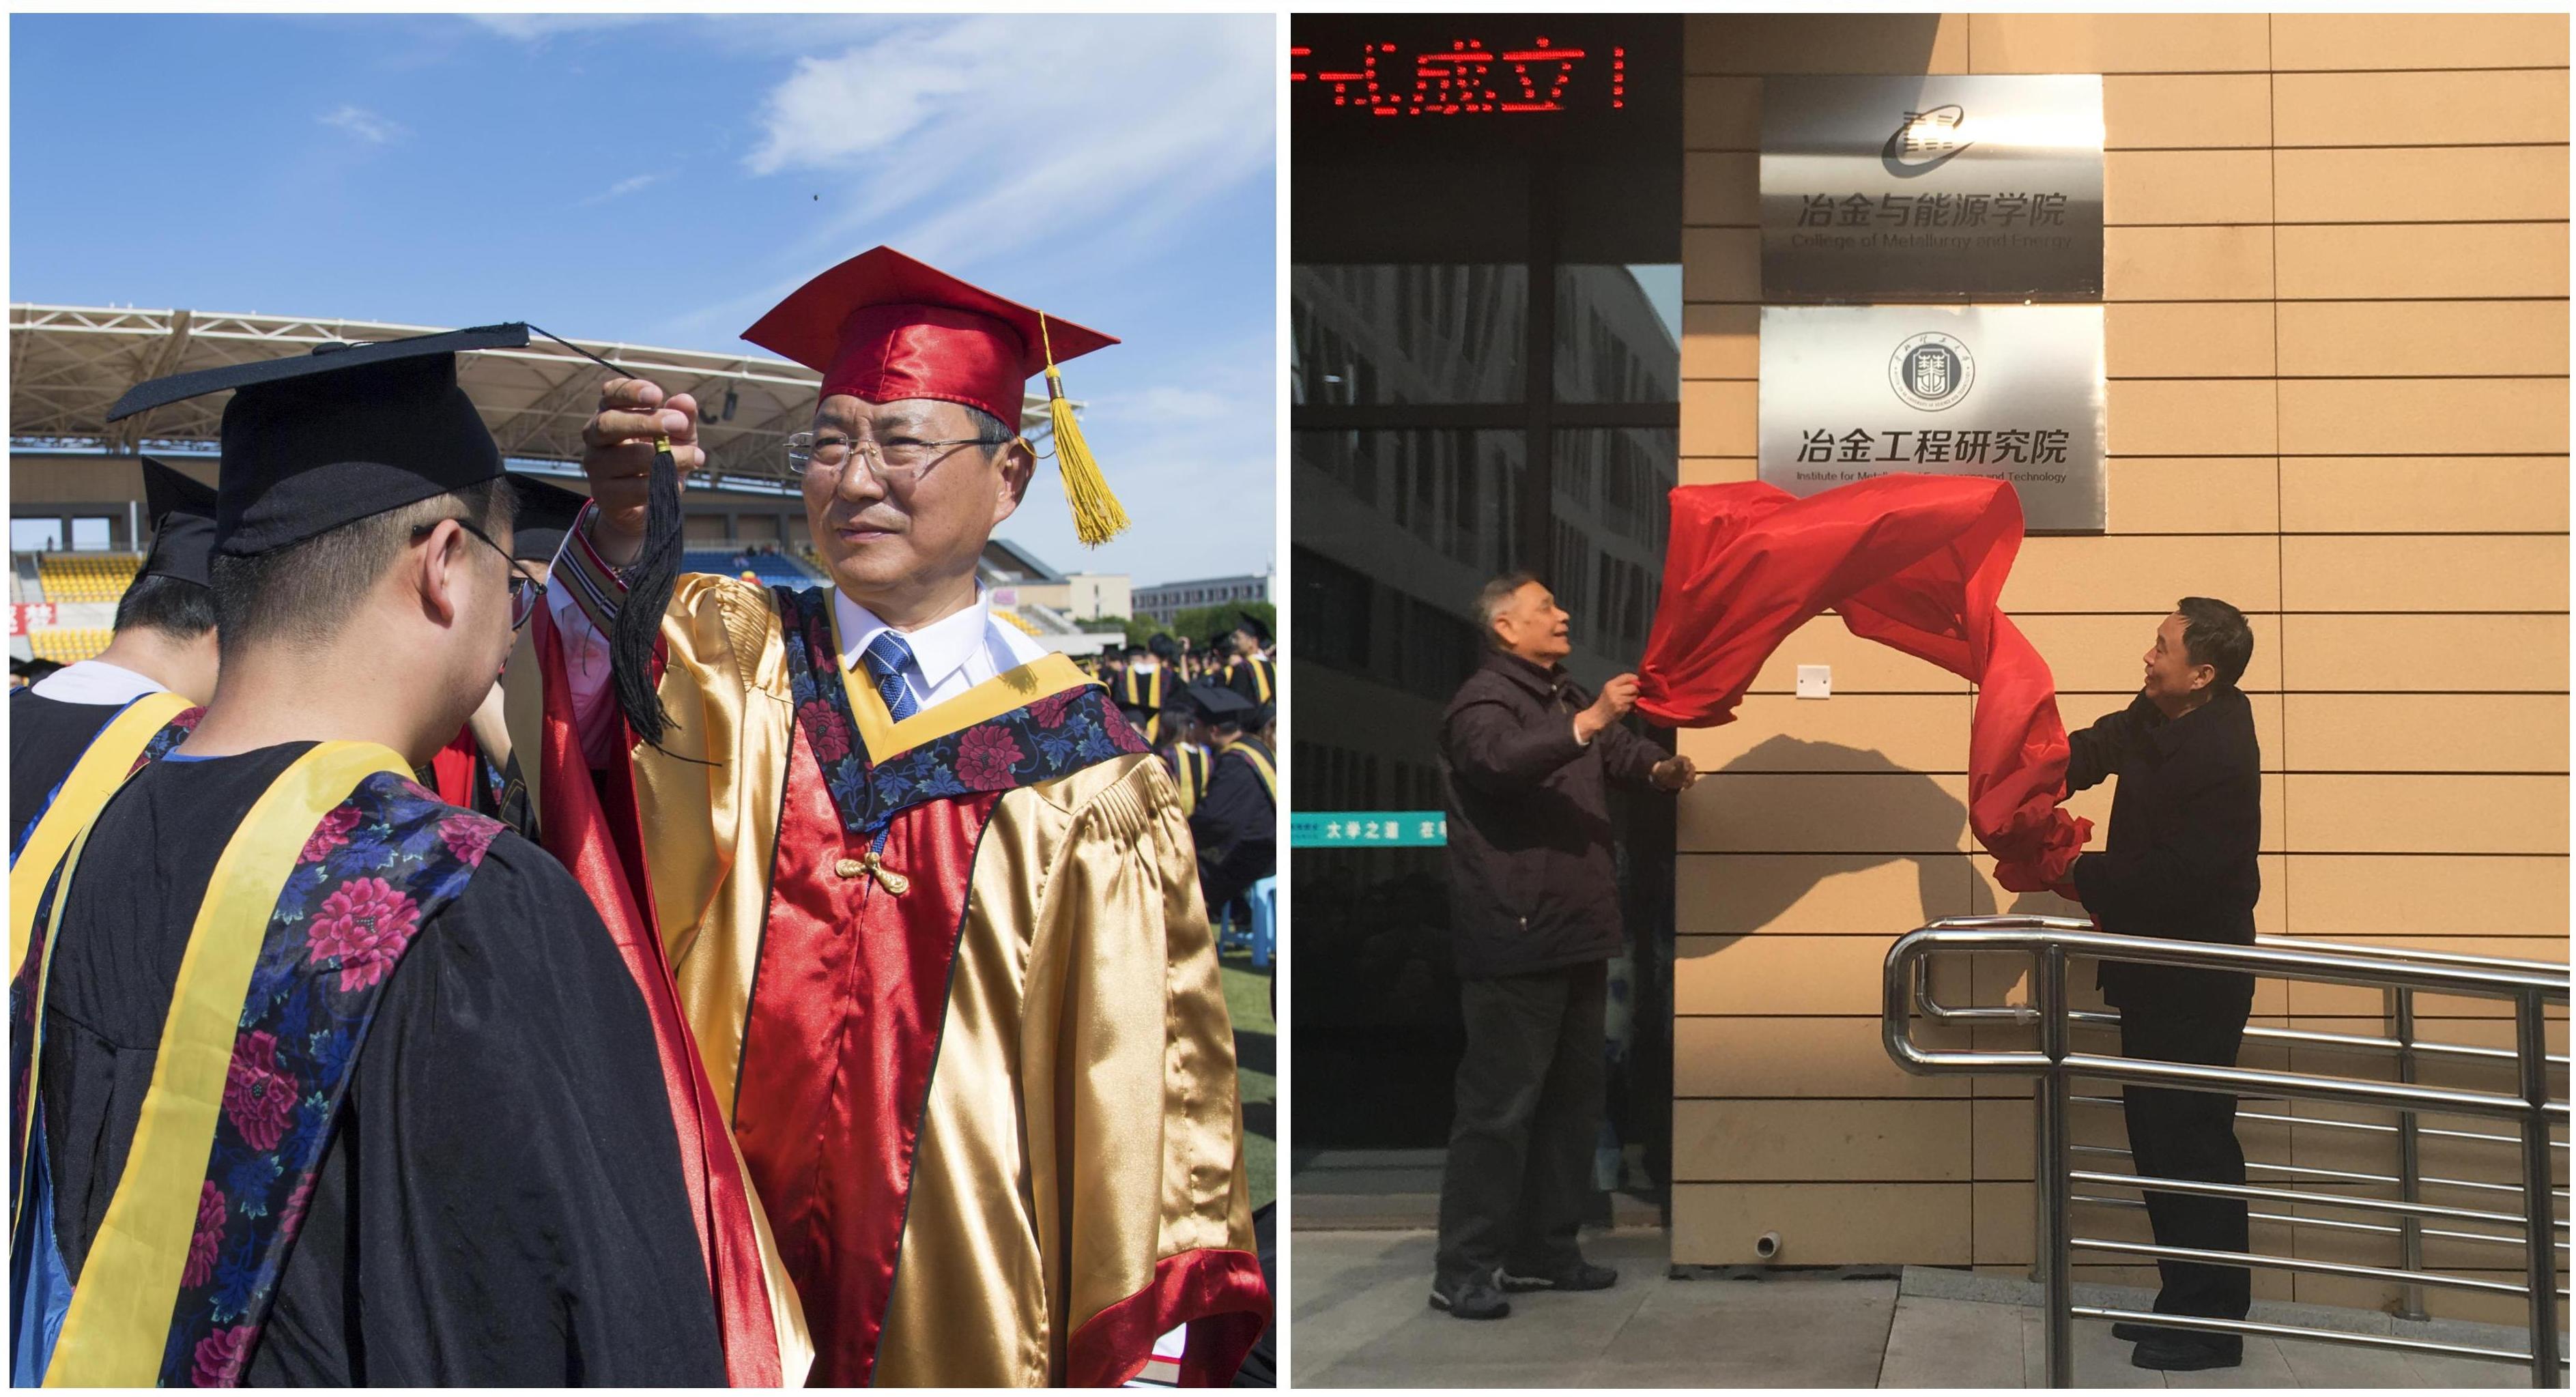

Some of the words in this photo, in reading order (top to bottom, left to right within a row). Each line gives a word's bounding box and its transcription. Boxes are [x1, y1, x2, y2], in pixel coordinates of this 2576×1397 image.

[1797, 192, 2067, 228] 冶金与能源学院
[1861, 233, 1877, 248] of
[1797, 428, 2070, 465] 冶金工程研究院
[1797, 471, 1837, 481] Institute
[1841, 471, 1854, 481] for
[2007, 471, 2067, 484] Technology
